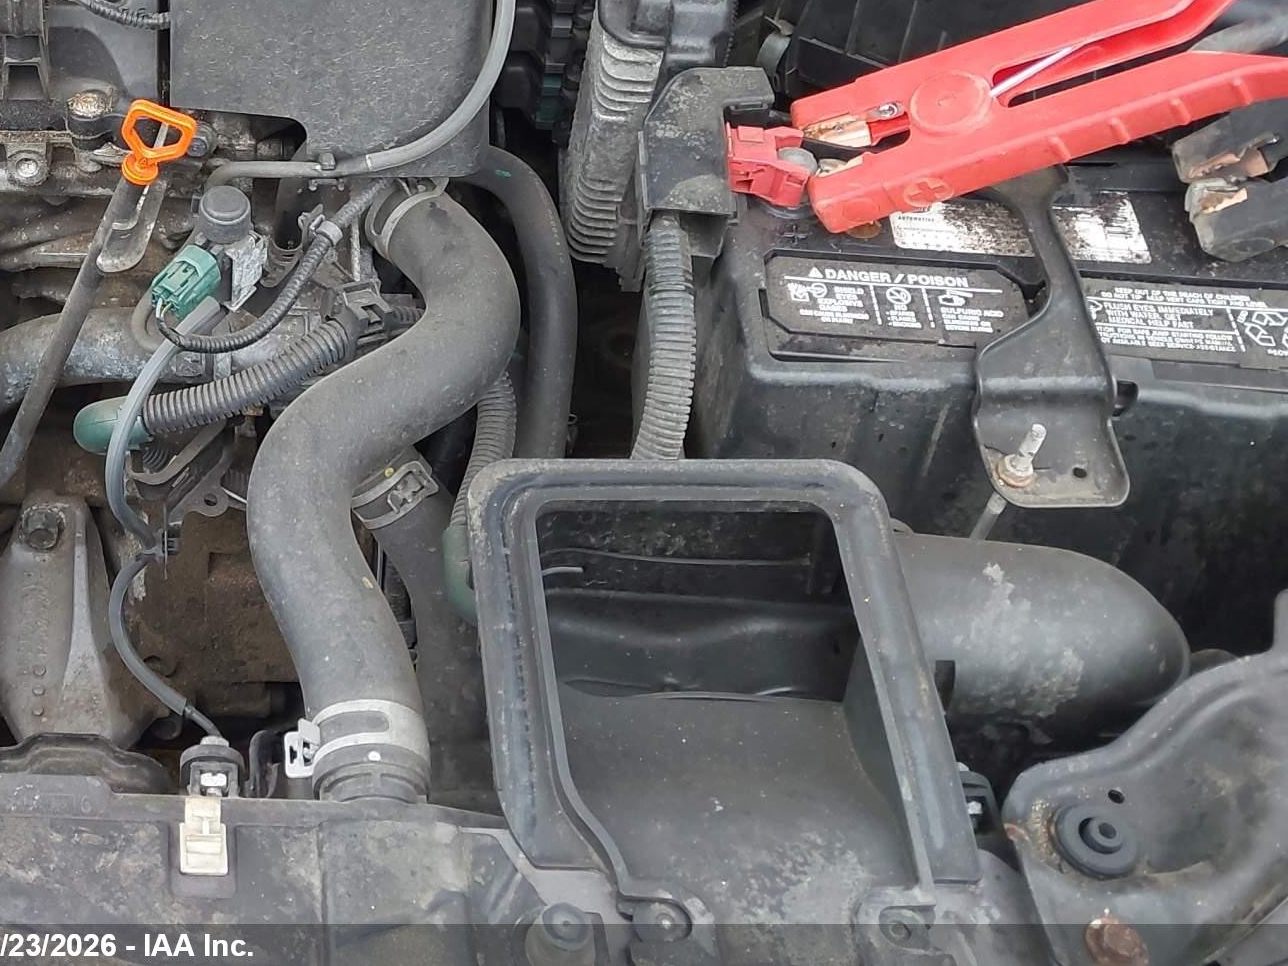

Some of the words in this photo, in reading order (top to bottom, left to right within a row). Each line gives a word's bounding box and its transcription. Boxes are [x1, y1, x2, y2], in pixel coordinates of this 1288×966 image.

[824, 268, 892, 283] DANGER
[906, 274, 969, 288] POISON
[1103, 302, 1132, 311] FLUSH
[1132, 304, 1157, 312] EYES
[1157, 306, 1214, 316] IMMEDIATELY
[1105, 310, 1129, 318] WITH
[1108, 316, 1147, 326] MEDICAL
[1147, 319, 1171, 327] HELP
